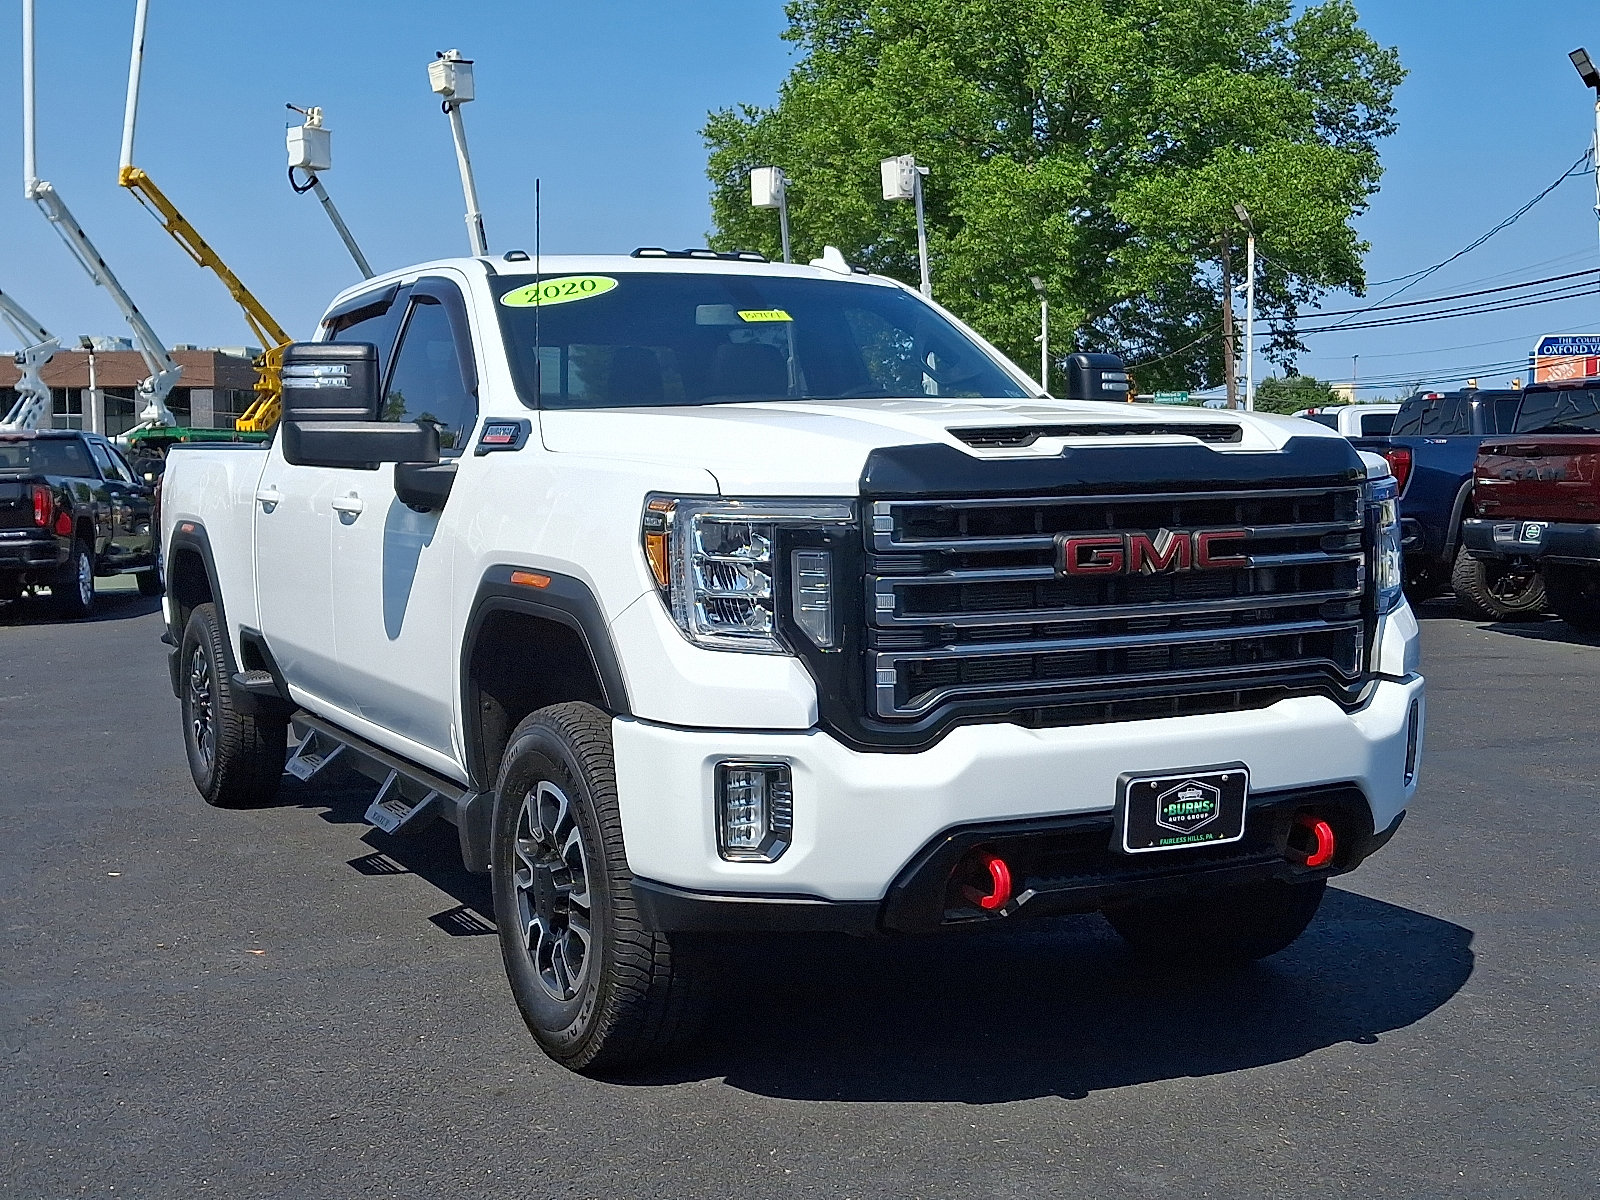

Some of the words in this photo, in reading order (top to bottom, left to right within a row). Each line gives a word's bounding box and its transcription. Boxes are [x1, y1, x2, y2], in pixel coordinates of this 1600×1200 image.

[525, 280, 597, 303] 2020
[1543, 345, 1588, 355] OXFORD
[1501, 467, 1566, 481] RAM
[1054, 528, 1247, 575] GMC
[1168, 800, 1210, 816] BURNS
[1160, 836, 1187, 845] FAIRLESS
[1187, 834, 1205, 842] HILLS,
